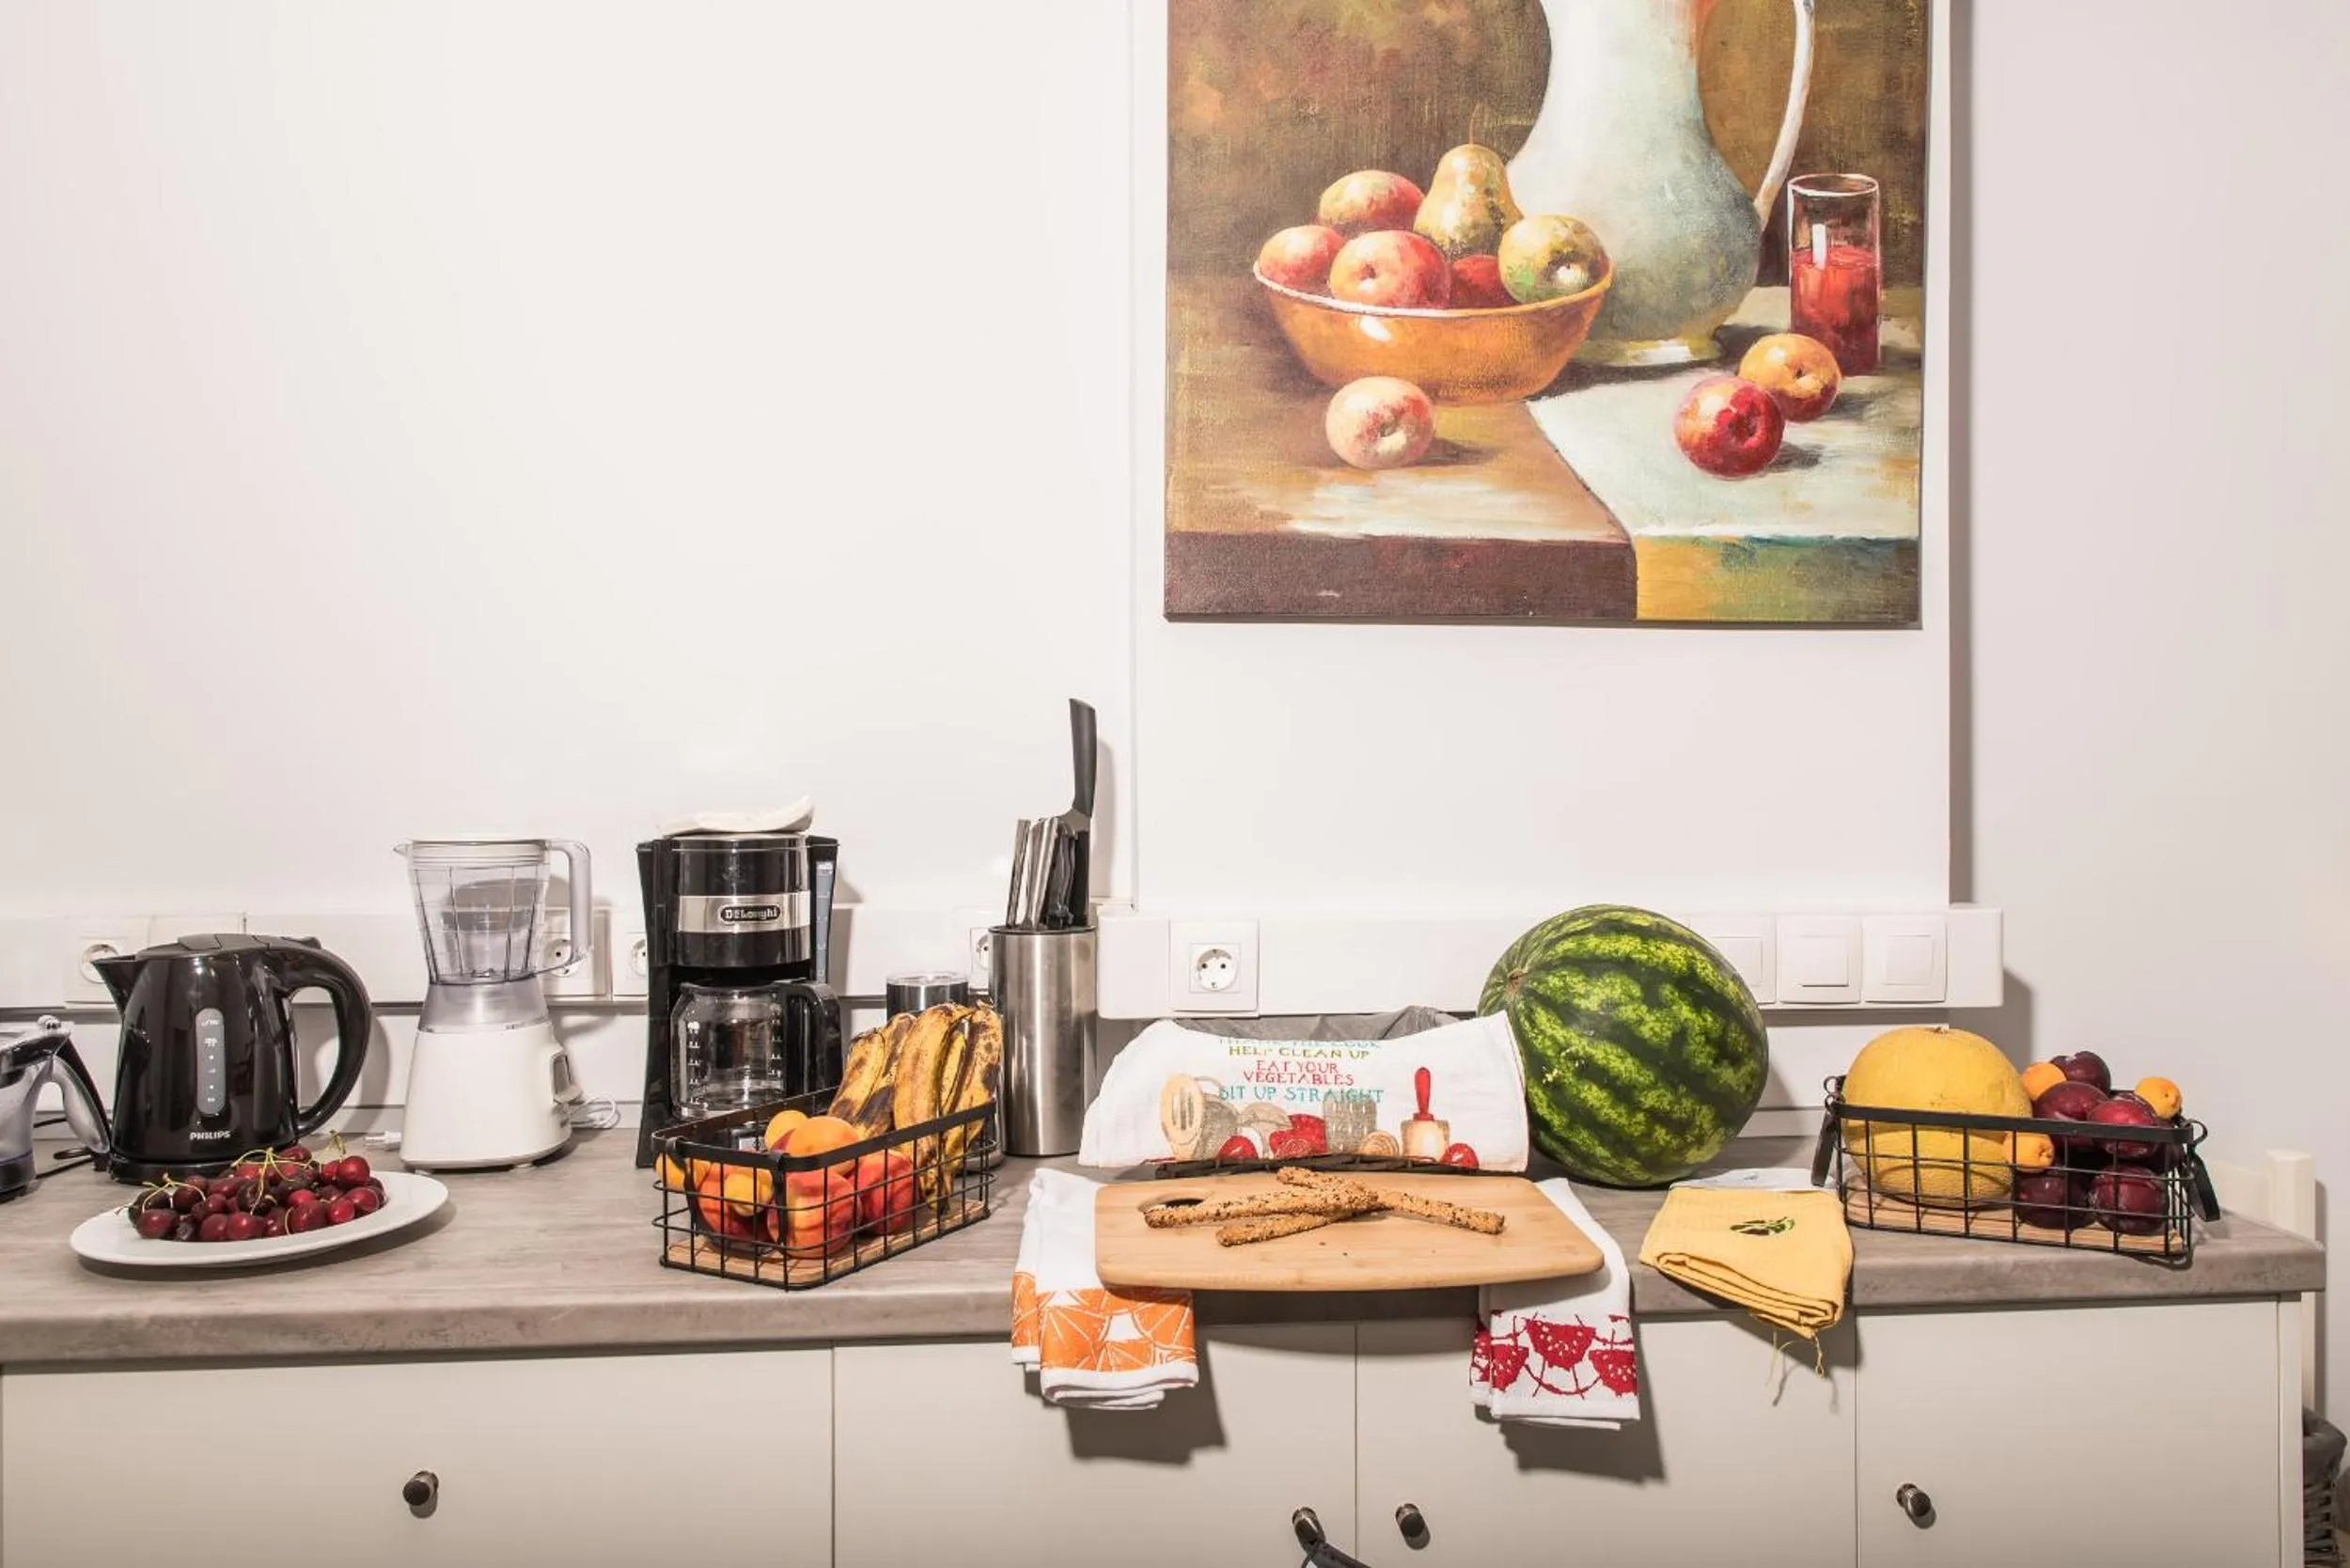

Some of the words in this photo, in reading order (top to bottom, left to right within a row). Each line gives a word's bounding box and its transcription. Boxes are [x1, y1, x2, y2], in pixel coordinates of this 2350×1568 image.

[1230, 1045, 1273, 1056] HELP
[1278, 1046, 1341, 1058] CLEAN
[1350, 1050, 1370, 1060] UP
[1256, 1059, 1292, 1072] EAT
[1297, 1061, 1339, 1074] YOUR
[1243, 1071, 1355, 1086] VEGETABLES
[1219, 1086, 1246, 1101] SIT
[1254, 1087, 1277, 1102] UP
[1284, 1087, 1384, 1104] STRAIGHT
[190, 1131, 230, 1140] PHILIPS
